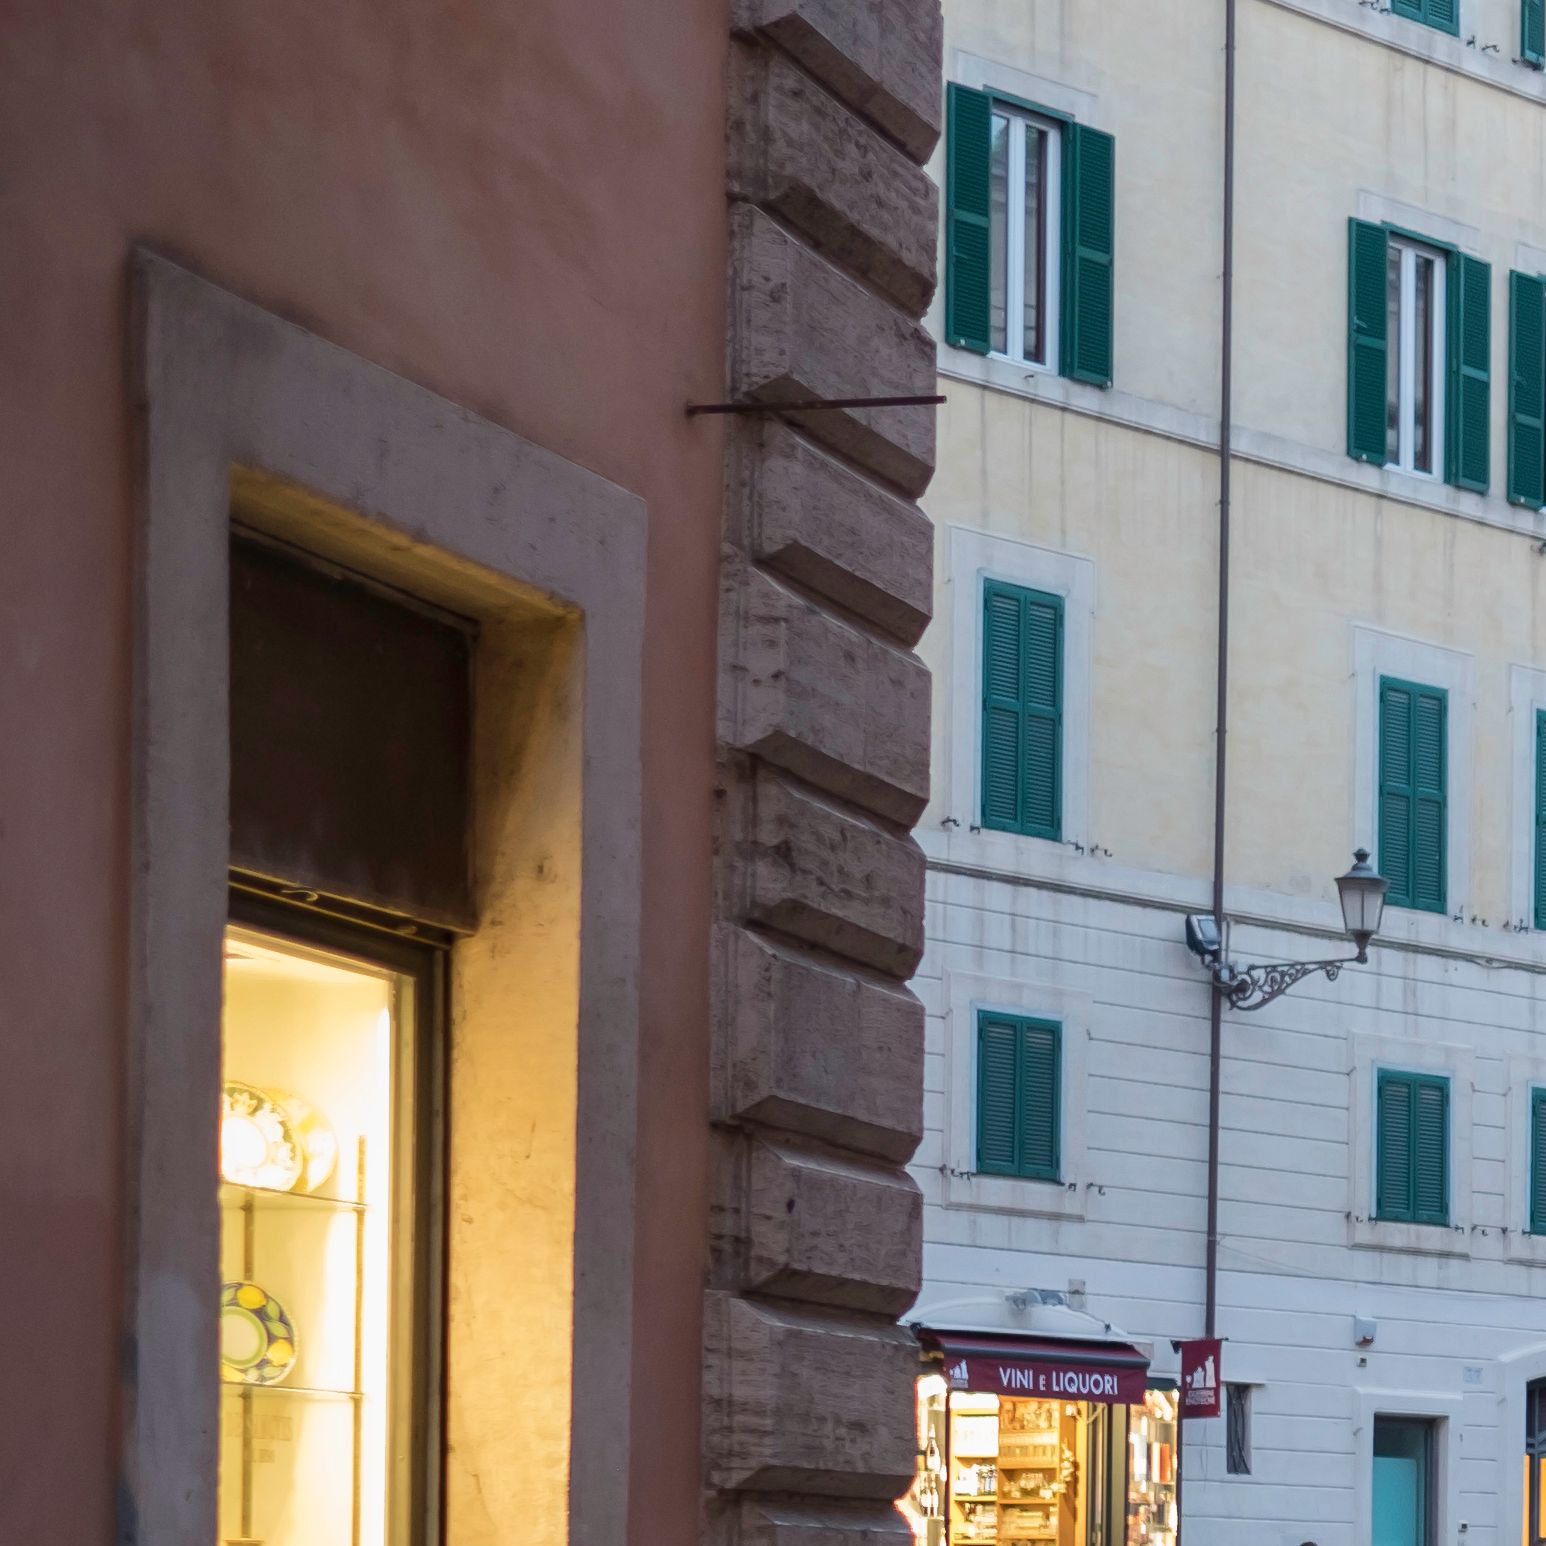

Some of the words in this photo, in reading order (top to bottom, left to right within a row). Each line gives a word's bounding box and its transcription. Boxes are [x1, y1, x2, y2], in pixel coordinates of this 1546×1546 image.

[999, 1366, 1033, 1389] VINI
[1039, 1375, 1046, 1391] E
[1052, 1371, 1118, 1395] LIQUORI
